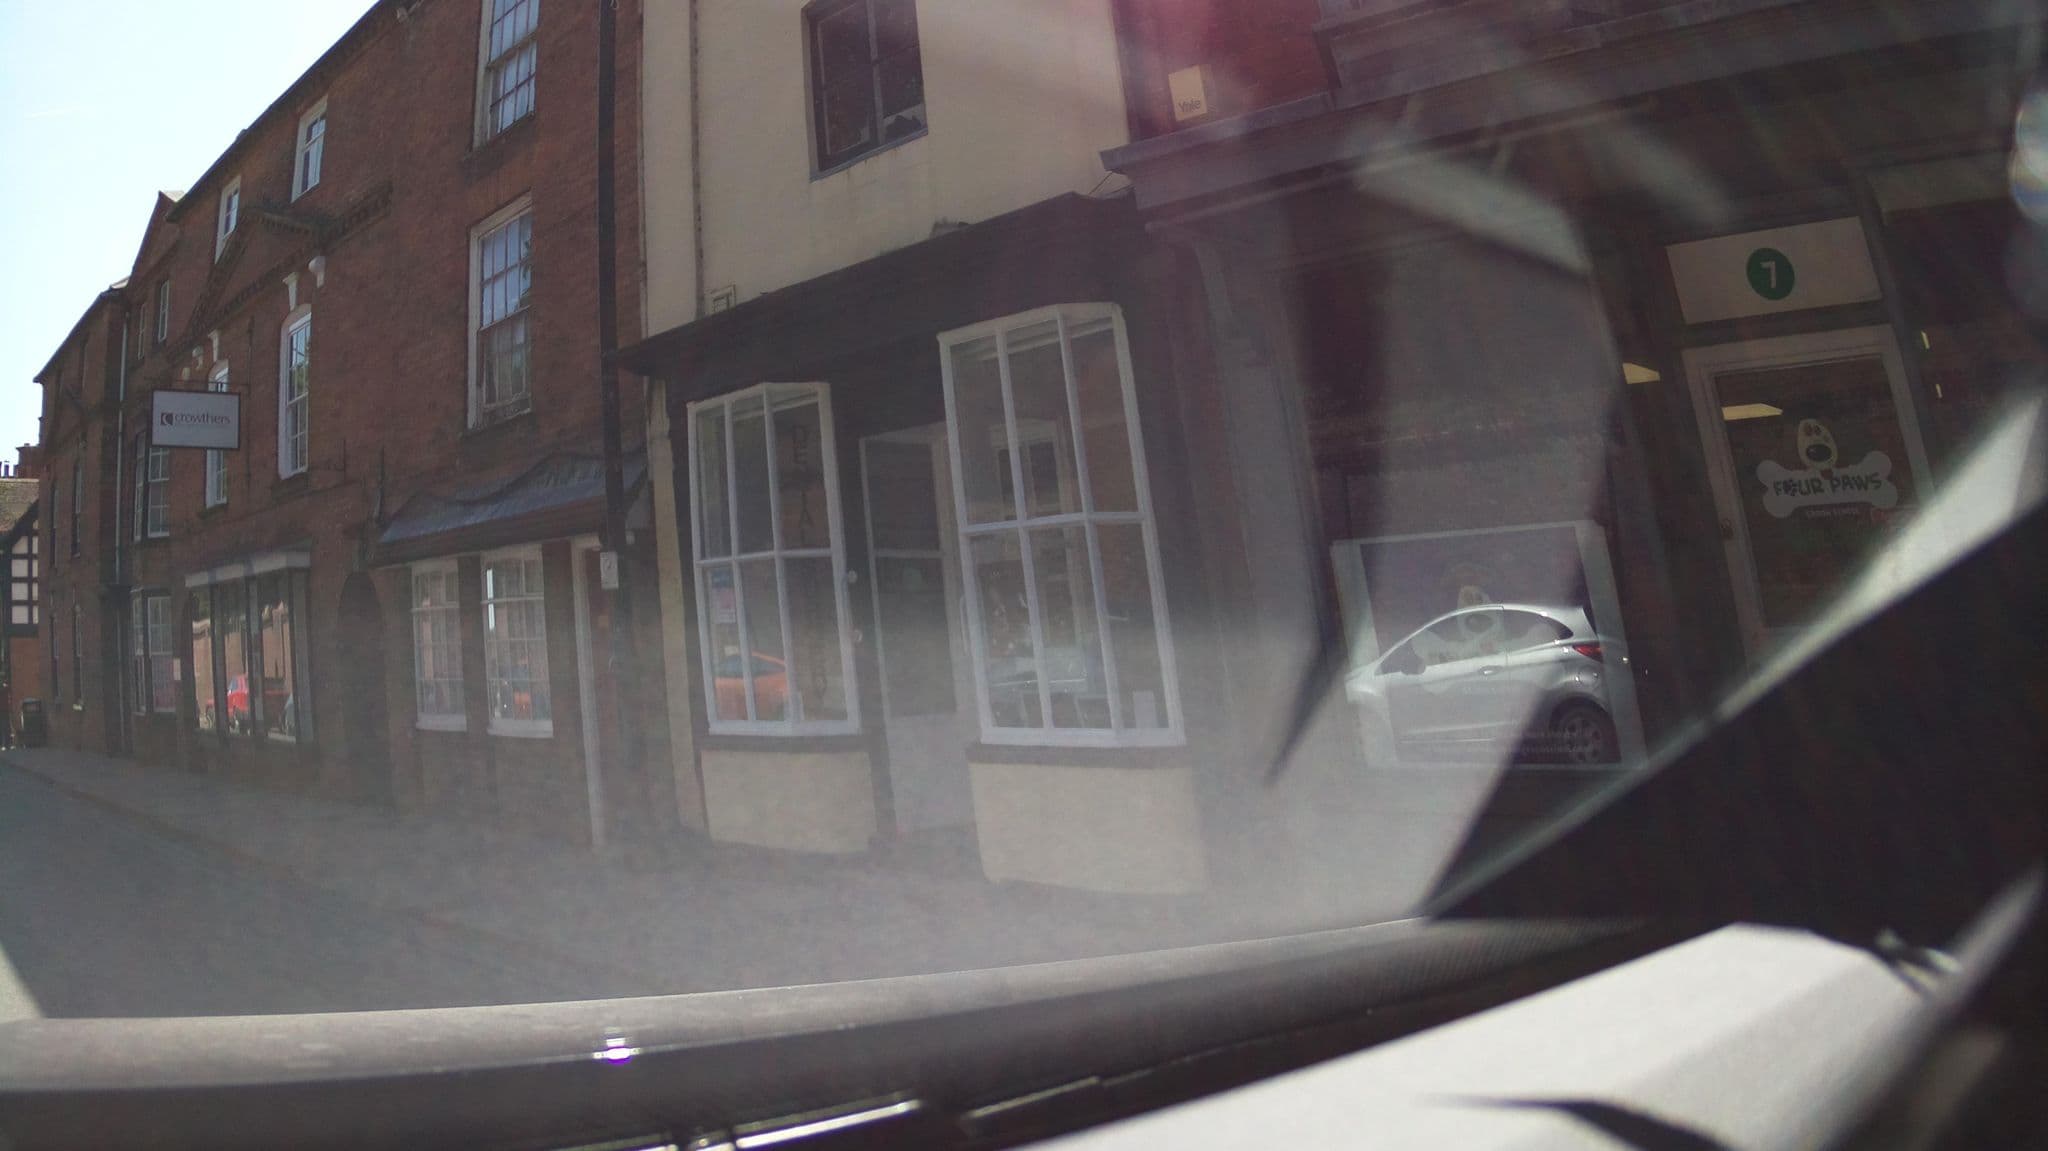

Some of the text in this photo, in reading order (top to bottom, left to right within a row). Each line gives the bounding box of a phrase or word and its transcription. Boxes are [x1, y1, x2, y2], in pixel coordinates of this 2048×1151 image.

[1760, 261, 1776, 289] 7
[174, 412, 232, 425] crowthers
[1773, 472, 1883, 497] FOUR PAWS
